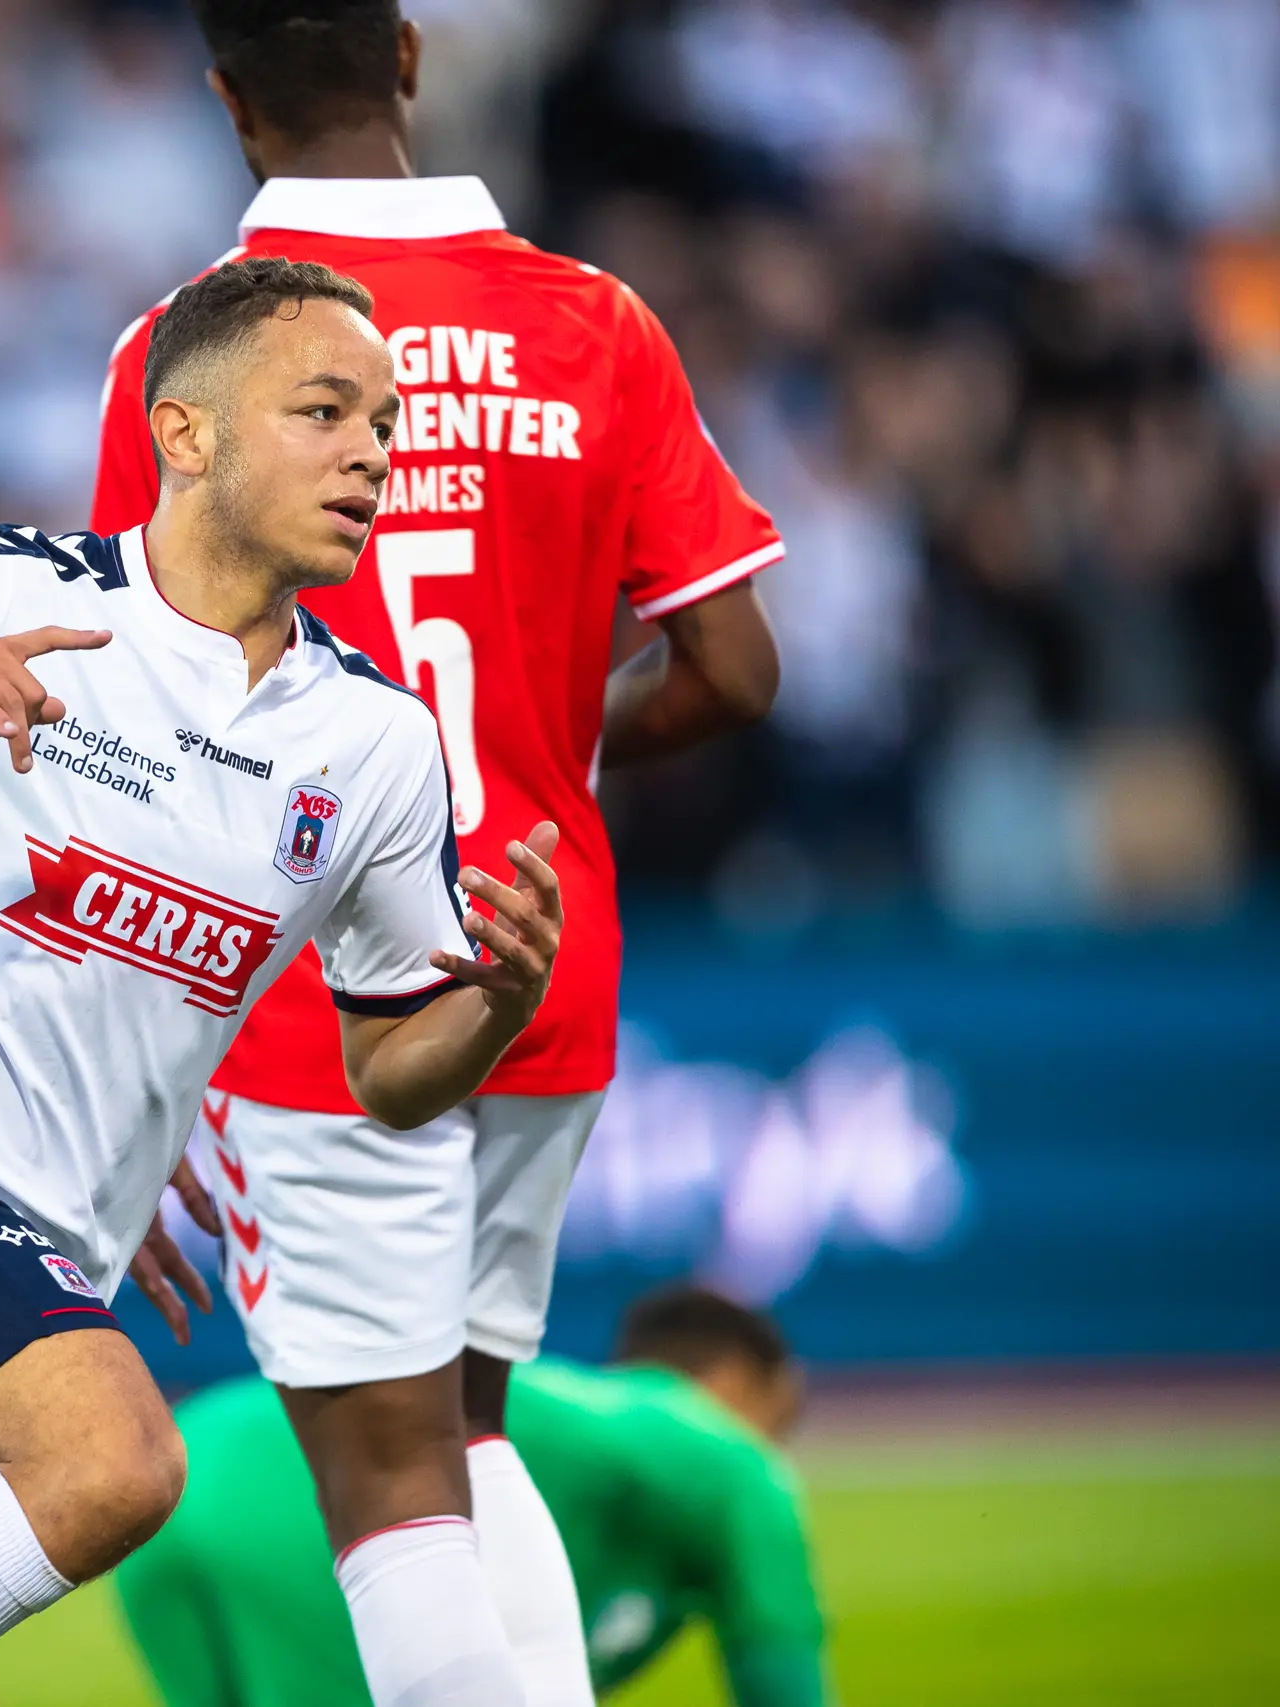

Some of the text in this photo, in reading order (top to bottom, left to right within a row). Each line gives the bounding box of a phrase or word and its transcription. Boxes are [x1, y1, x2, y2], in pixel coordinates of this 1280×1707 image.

[387, 325, 518, 388] GIVE
[376, 528, 486, 836] 5
[31, 733, 155, 804] Landsbank
[52, 717, 177, 782] rbejdernes
[201, 737, 273, 780] hummel
[286, 860, 314, 875] AARHUS
[72, 871, 252, 977] CERES
